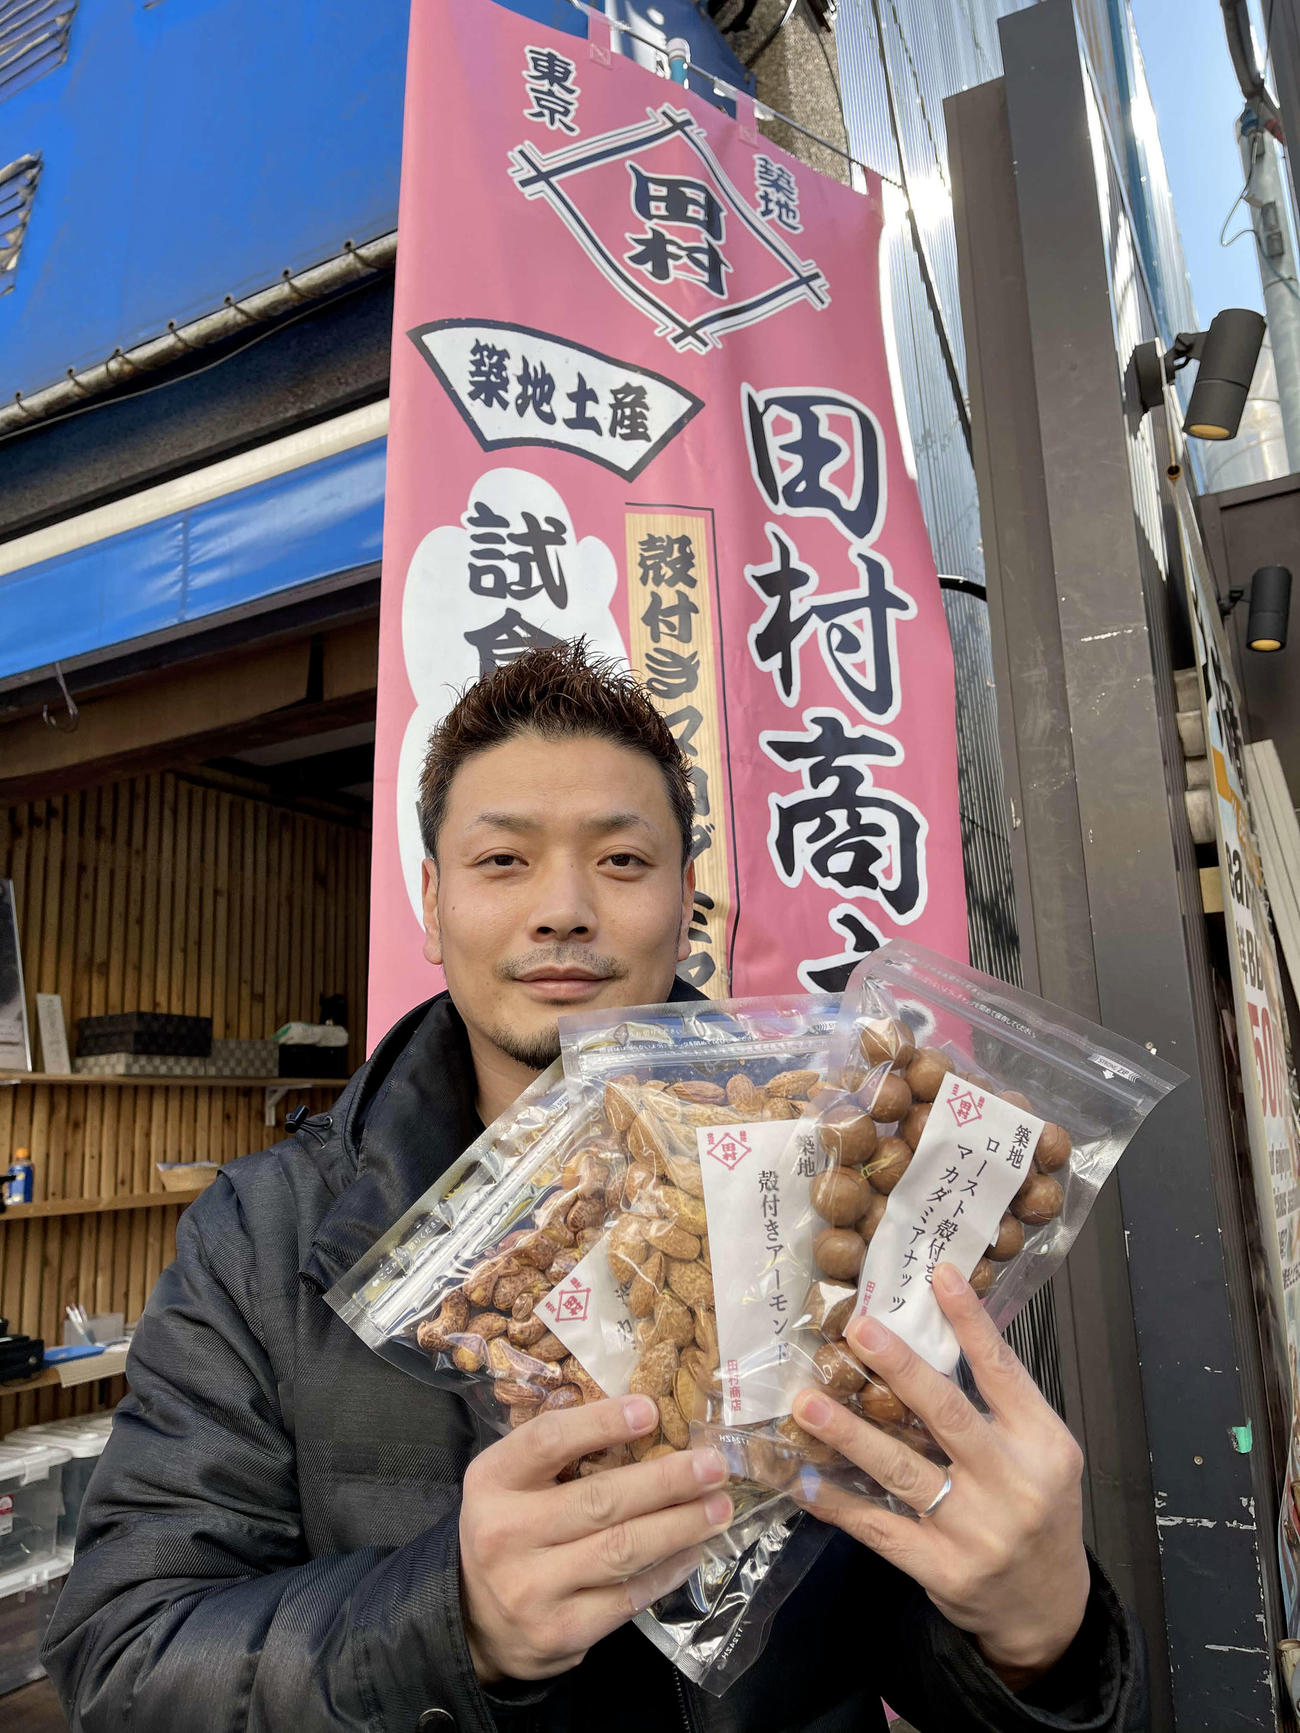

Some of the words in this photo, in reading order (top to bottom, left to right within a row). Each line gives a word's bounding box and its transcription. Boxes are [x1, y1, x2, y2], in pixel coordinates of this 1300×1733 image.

[524, 47, 580, 135] 東京
[626, 160, 732, 298] 田村
[753, 154, 803, 232] 築地
[467, 337, 653, 443] 築地土産
[1006, 1124, 1033, 1170] 築地
[758, 1169, 789, 1366] 殻付きアーモンド
[889, 1143, 973, 1314] マカダミアナッツ
